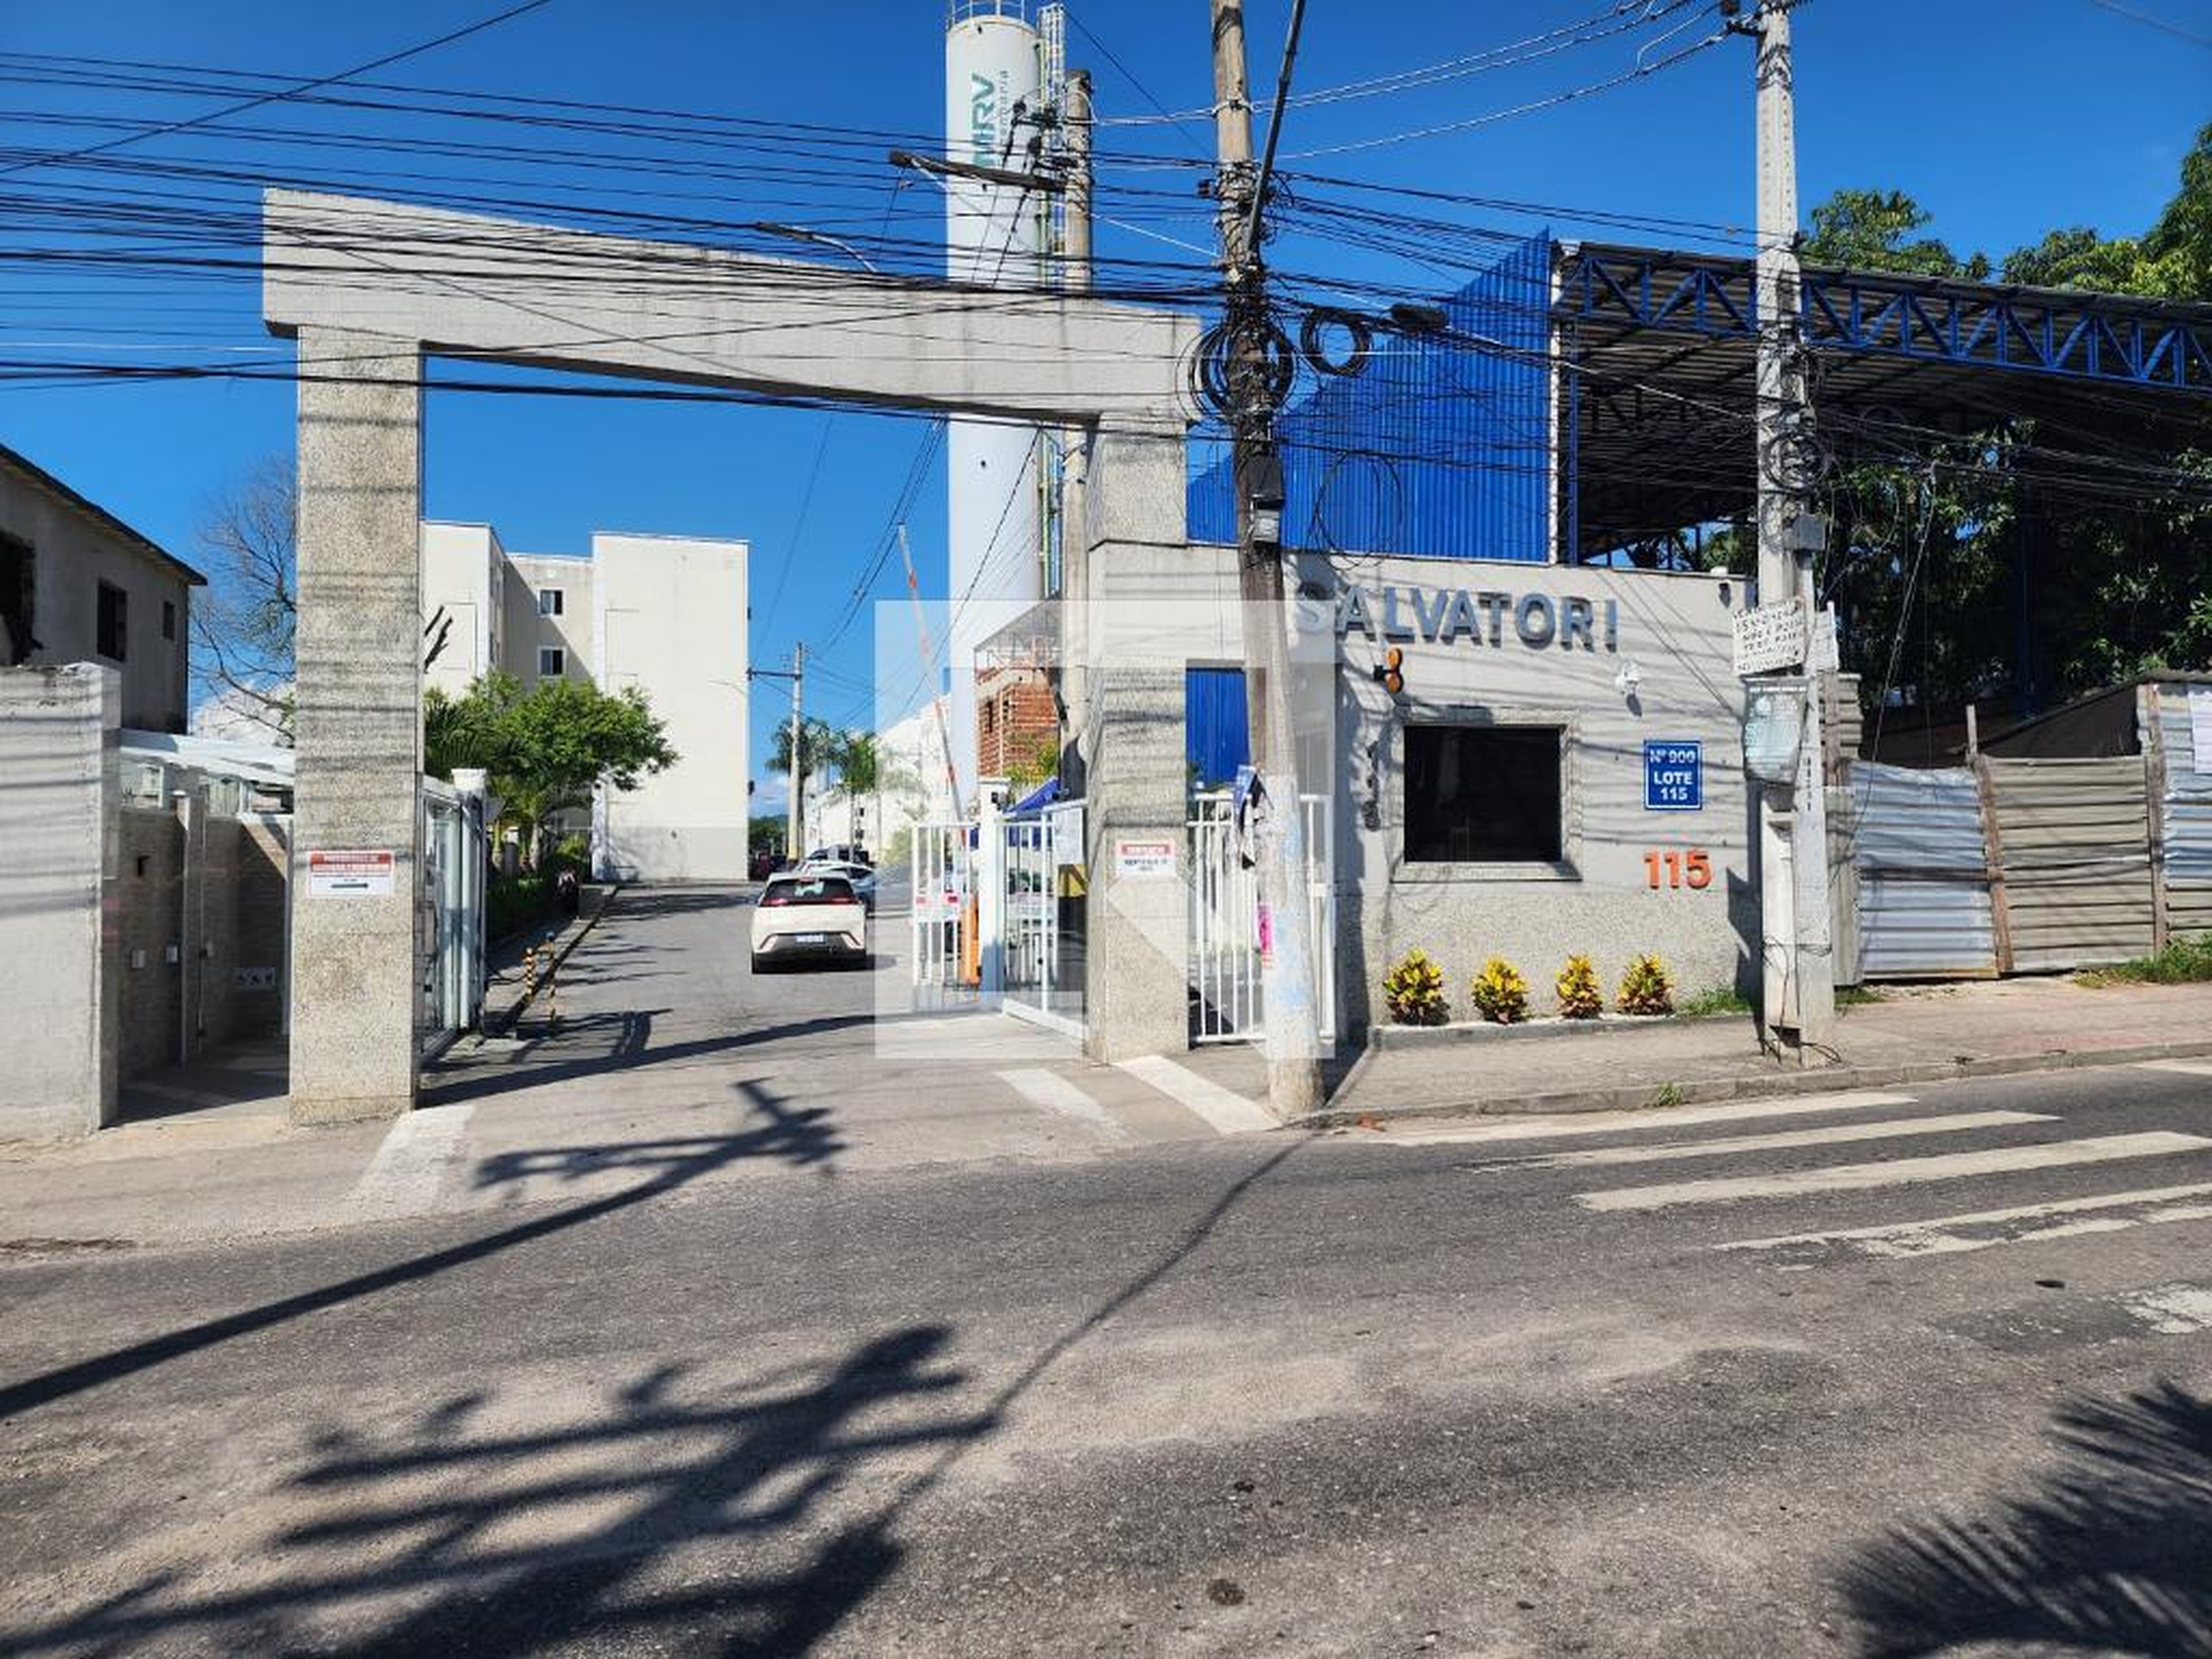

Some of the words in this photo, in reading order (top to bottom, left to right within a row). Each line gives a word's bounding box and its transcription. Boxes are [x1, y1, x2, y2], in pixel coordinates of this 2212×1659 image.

[971, 72, 995, 168] MRV
[1295, 582, 1618, 653] SALVATORI
[1654, 771, 1693, 785] LOTE
[1660, 786, 1688, 800] 115
[1645, 850, 1711, 889] 115
